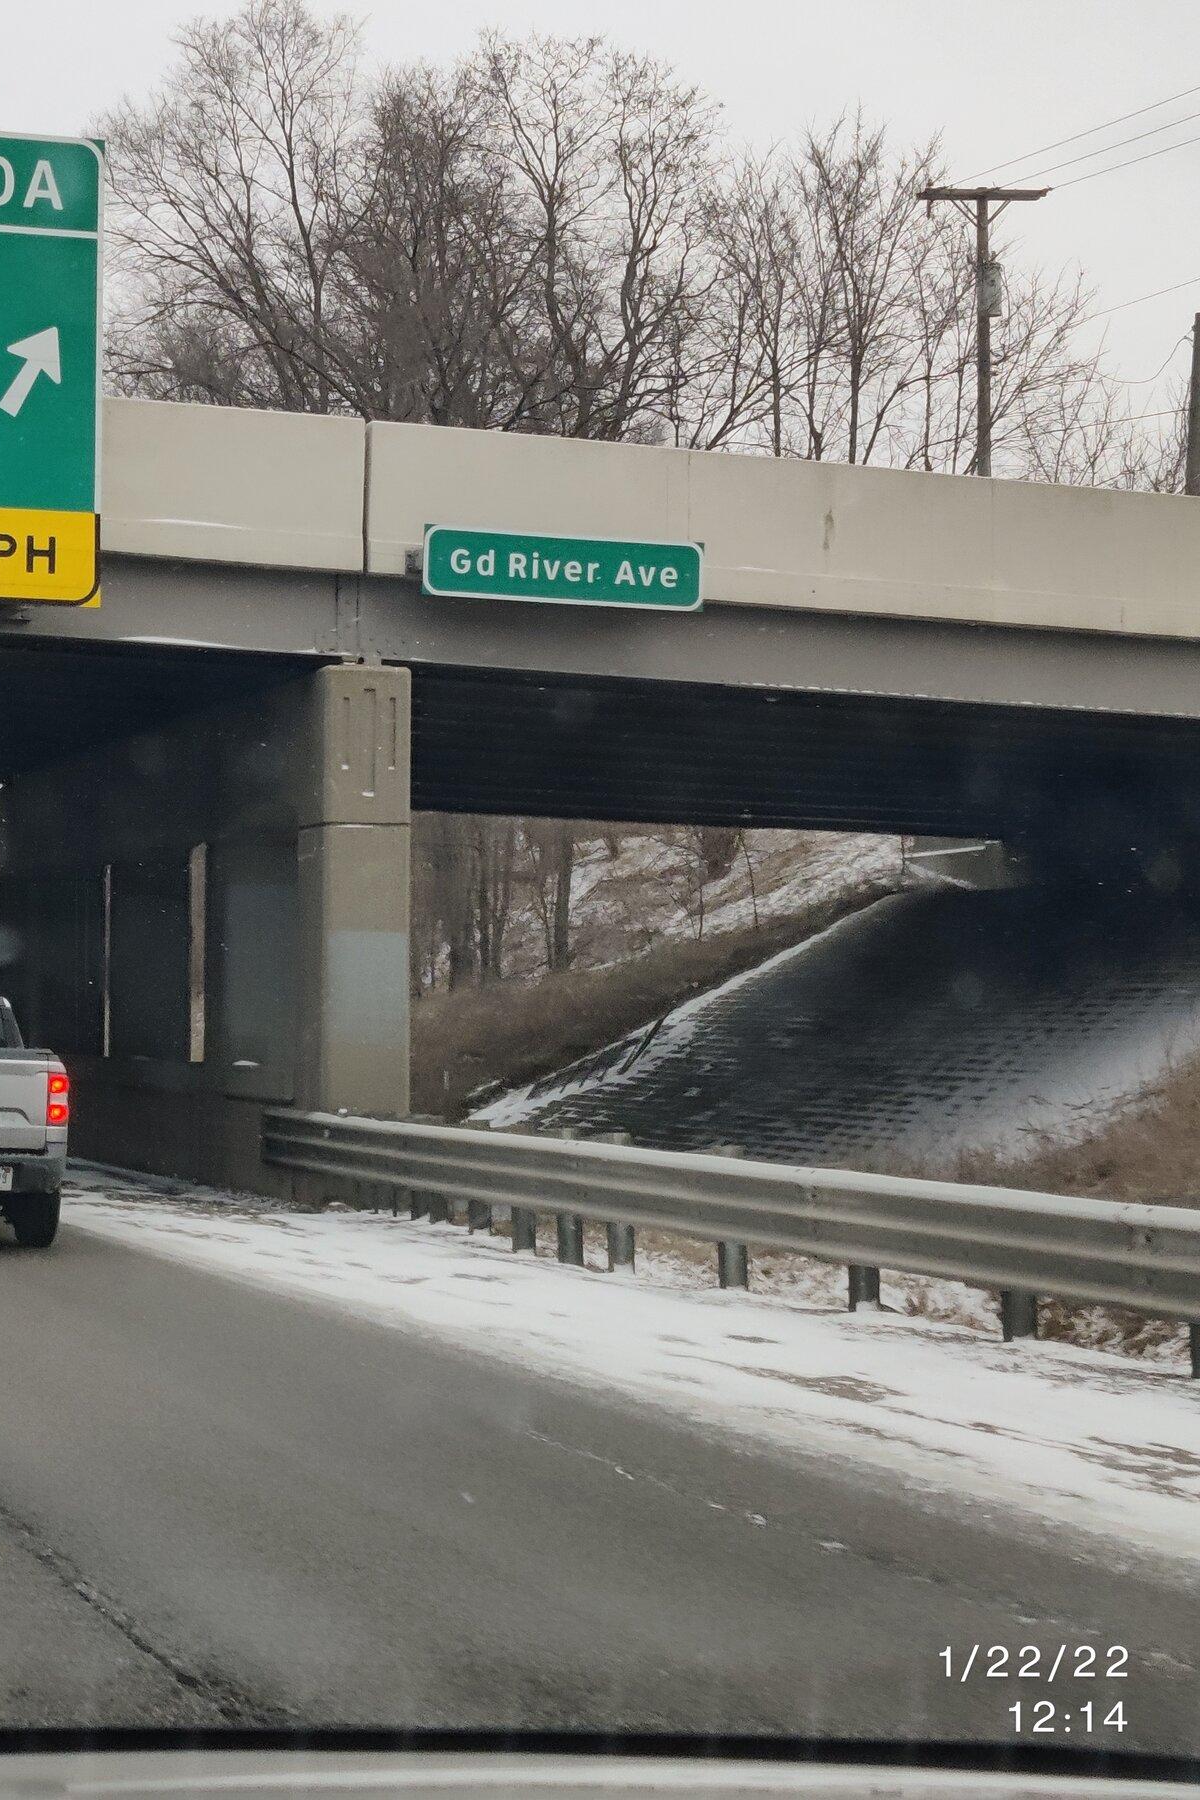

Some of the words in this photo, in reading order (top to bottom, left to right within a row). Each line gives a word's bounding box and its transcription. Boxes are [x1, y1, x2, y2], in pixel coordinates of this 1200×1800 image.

[450, 549, 495, 576] Gd
[508, 551, 599, 583] River
[614, 560, 678, 588] Ave
